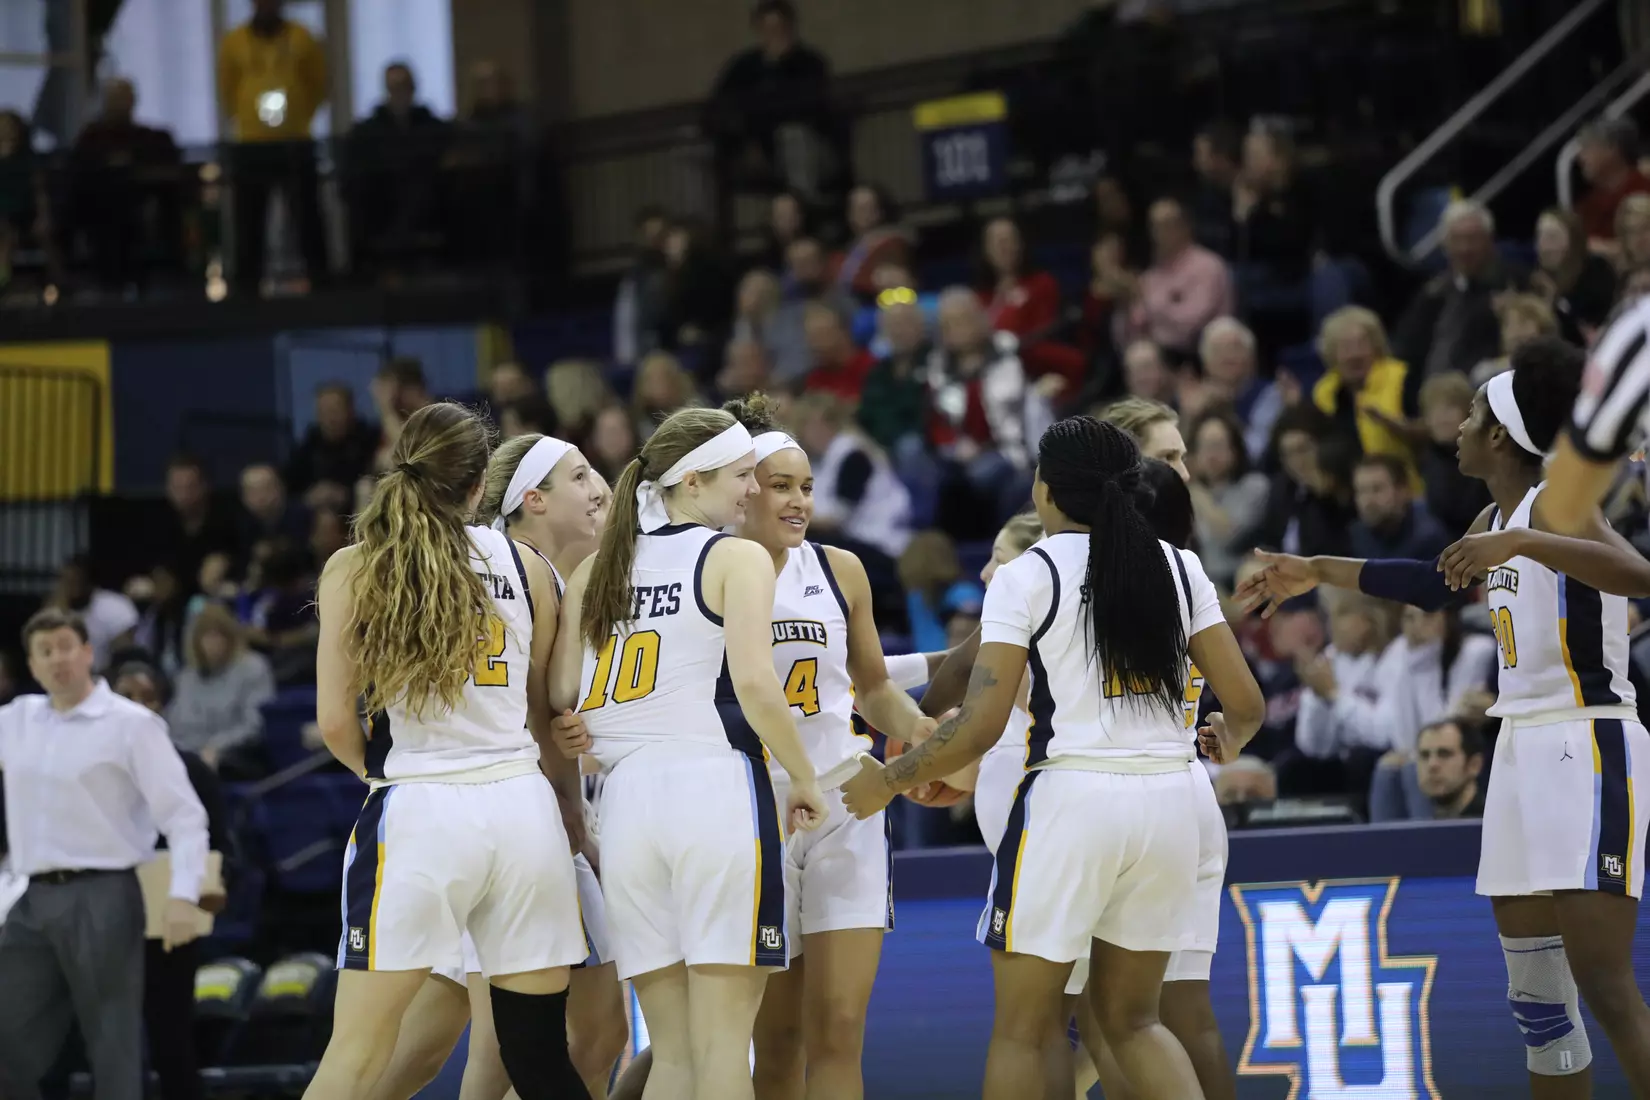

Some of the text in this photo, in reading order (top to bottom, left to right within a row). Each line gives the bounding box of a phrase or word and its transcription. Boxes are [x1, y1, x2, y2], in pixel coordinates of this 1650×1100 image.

[628, 582, 682, 619] FES
[578, 629, 661, 713] 10
[783, 657, 821, 717] 4
[1603, 855, 1623, 877] MU
[350, 928, 365, 950] MU
[761, 926, 781, 948] MU
[1254, 895, 1421, 1100] MU
